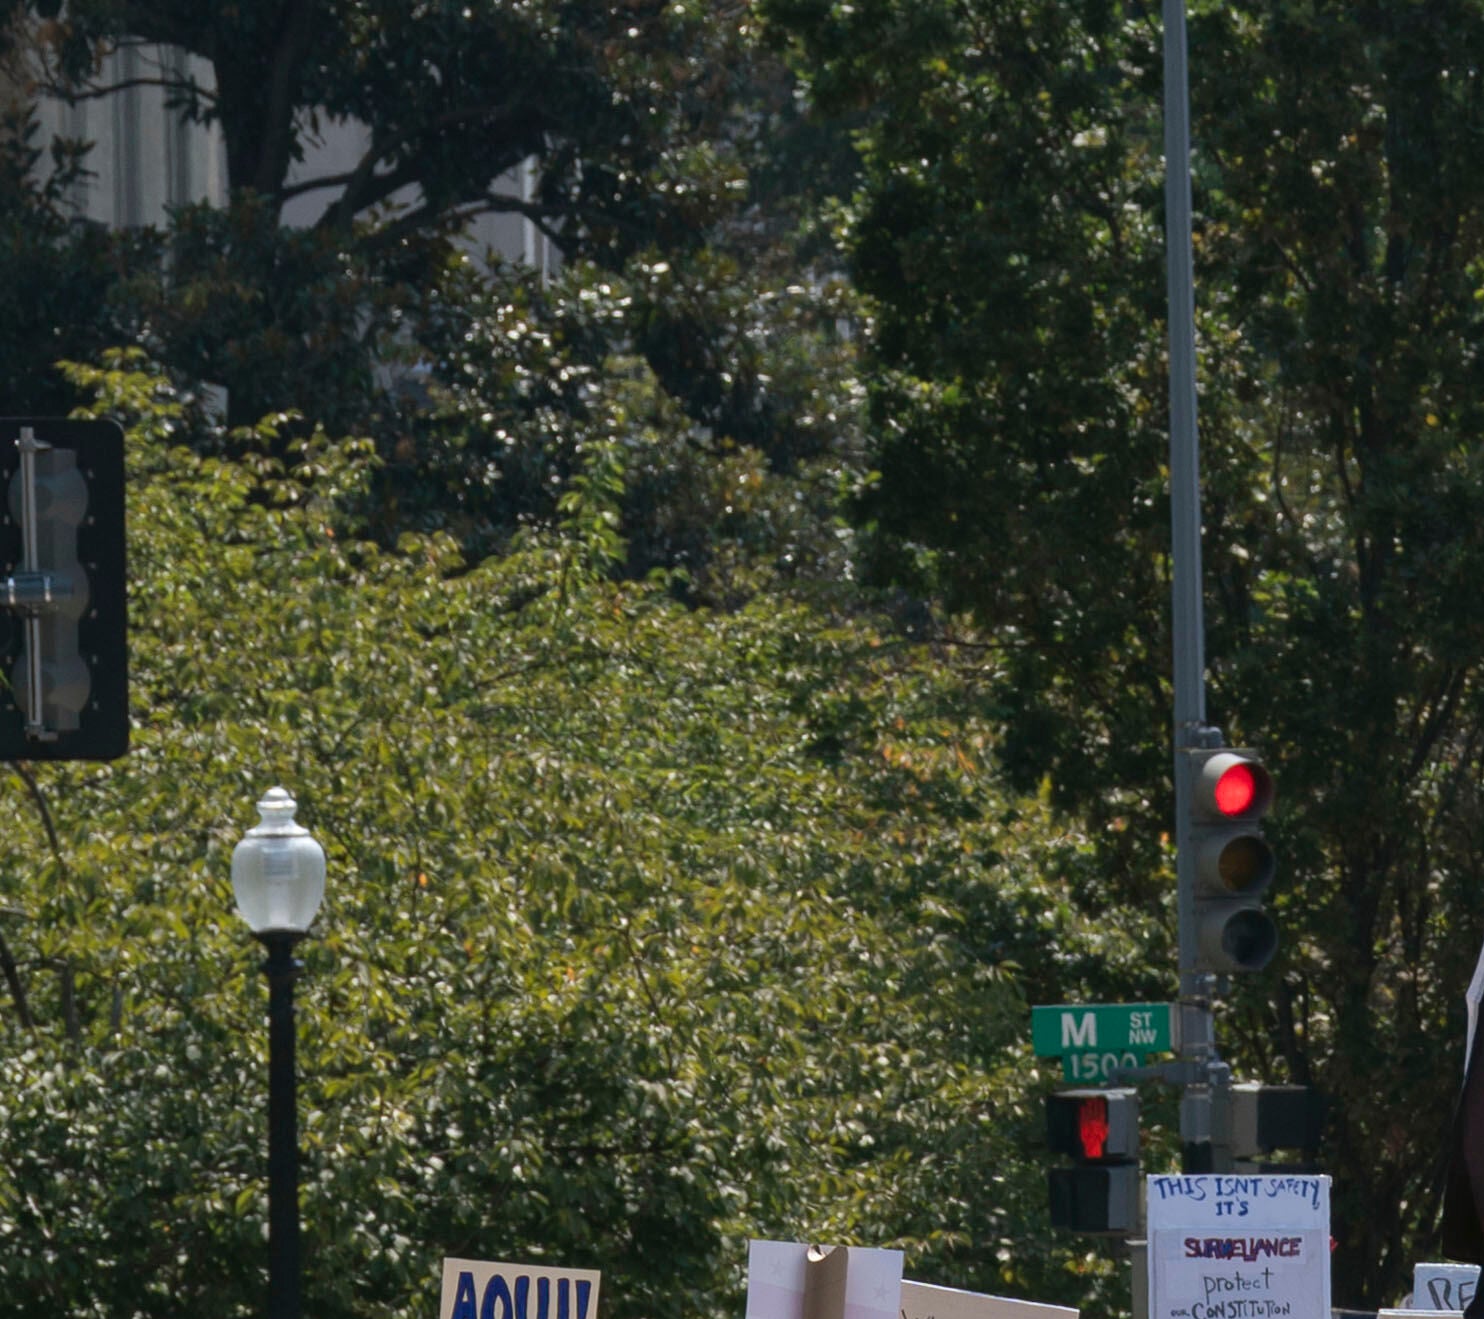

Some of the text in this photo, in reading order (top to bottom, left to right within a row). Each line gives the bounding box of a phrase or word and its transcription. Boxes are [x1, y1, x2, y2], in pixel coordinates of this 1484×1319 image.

[1060, 1012, 1153, 1047] M ST
[1129, 1028, 1158, 1046] NW
[1153, 1177, 1208, 1201] THIS
